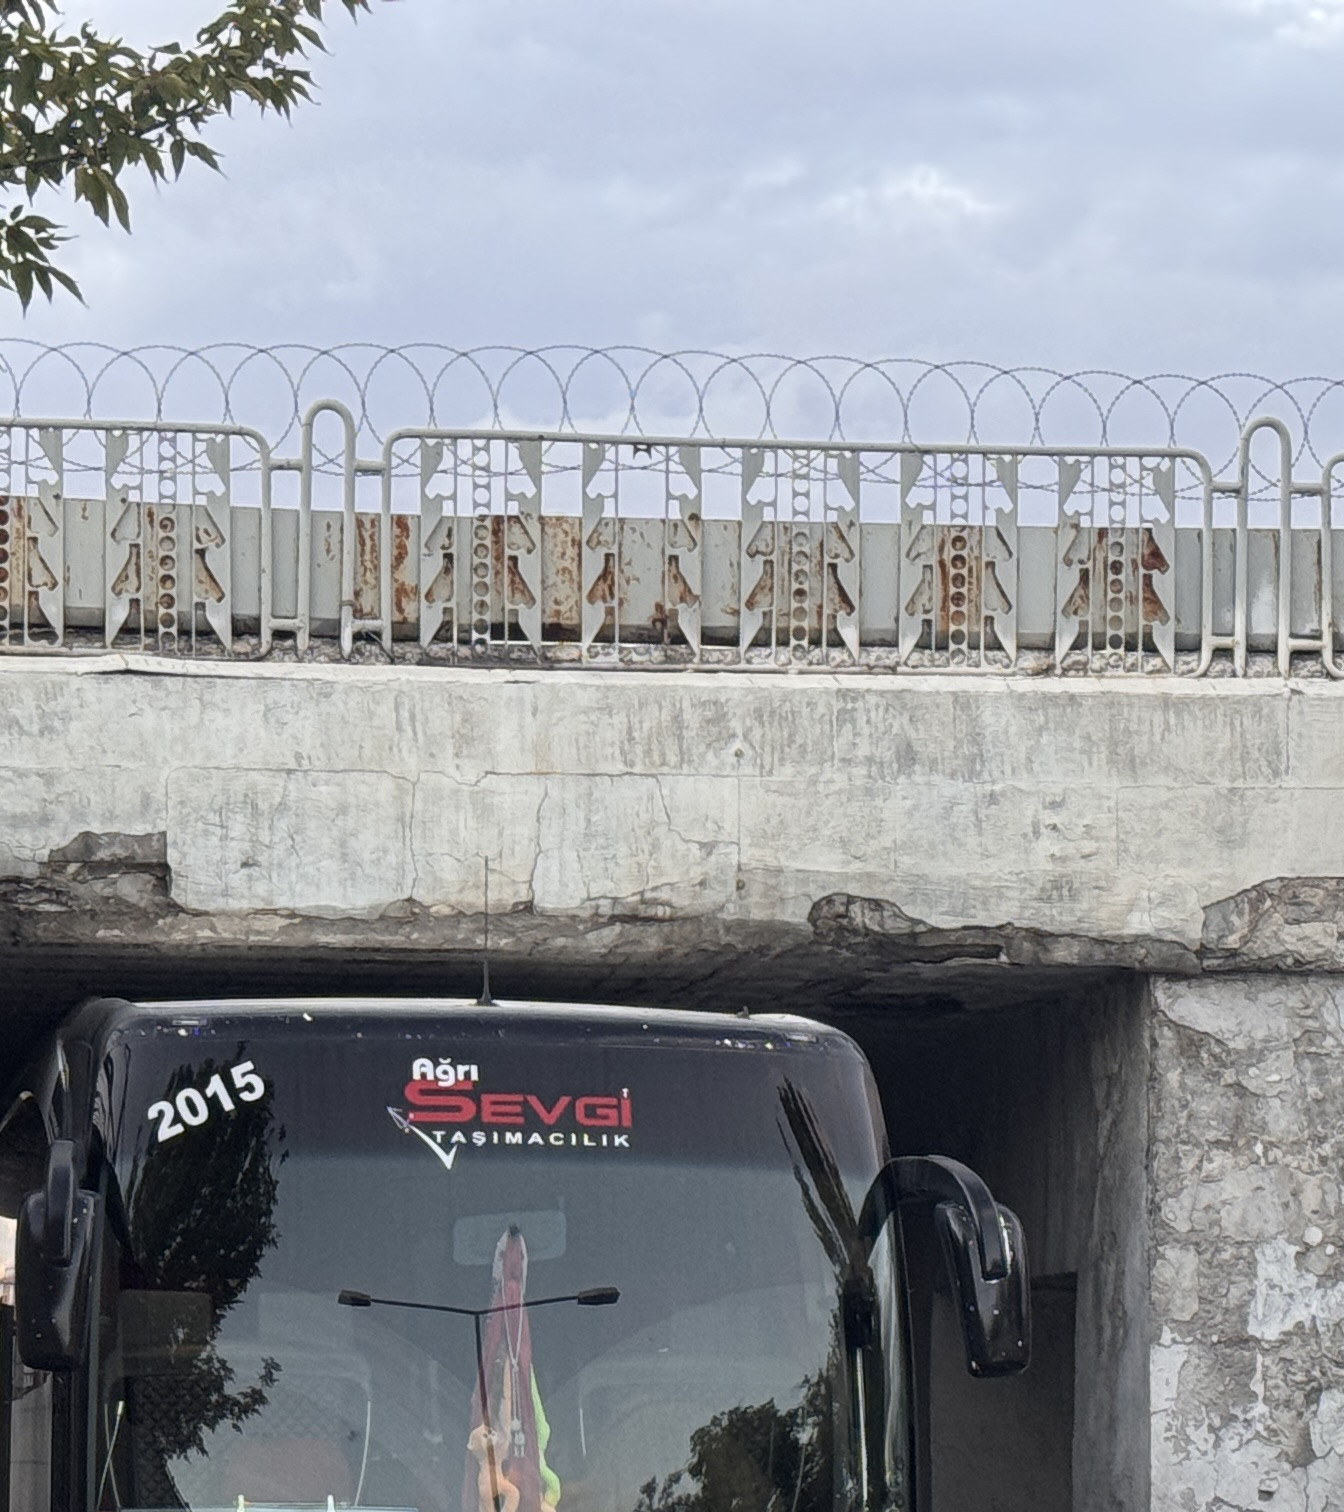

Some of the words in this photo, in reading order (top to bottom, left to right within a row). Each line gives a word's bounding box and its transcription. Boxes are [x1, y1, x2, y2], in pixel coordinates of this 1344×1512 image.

[412, 1057, 479, 1087] Ağrı
[147, 1060, 265, 1143] 2015
[432, 1130, 631, 1148] TAŞIMACILIK
